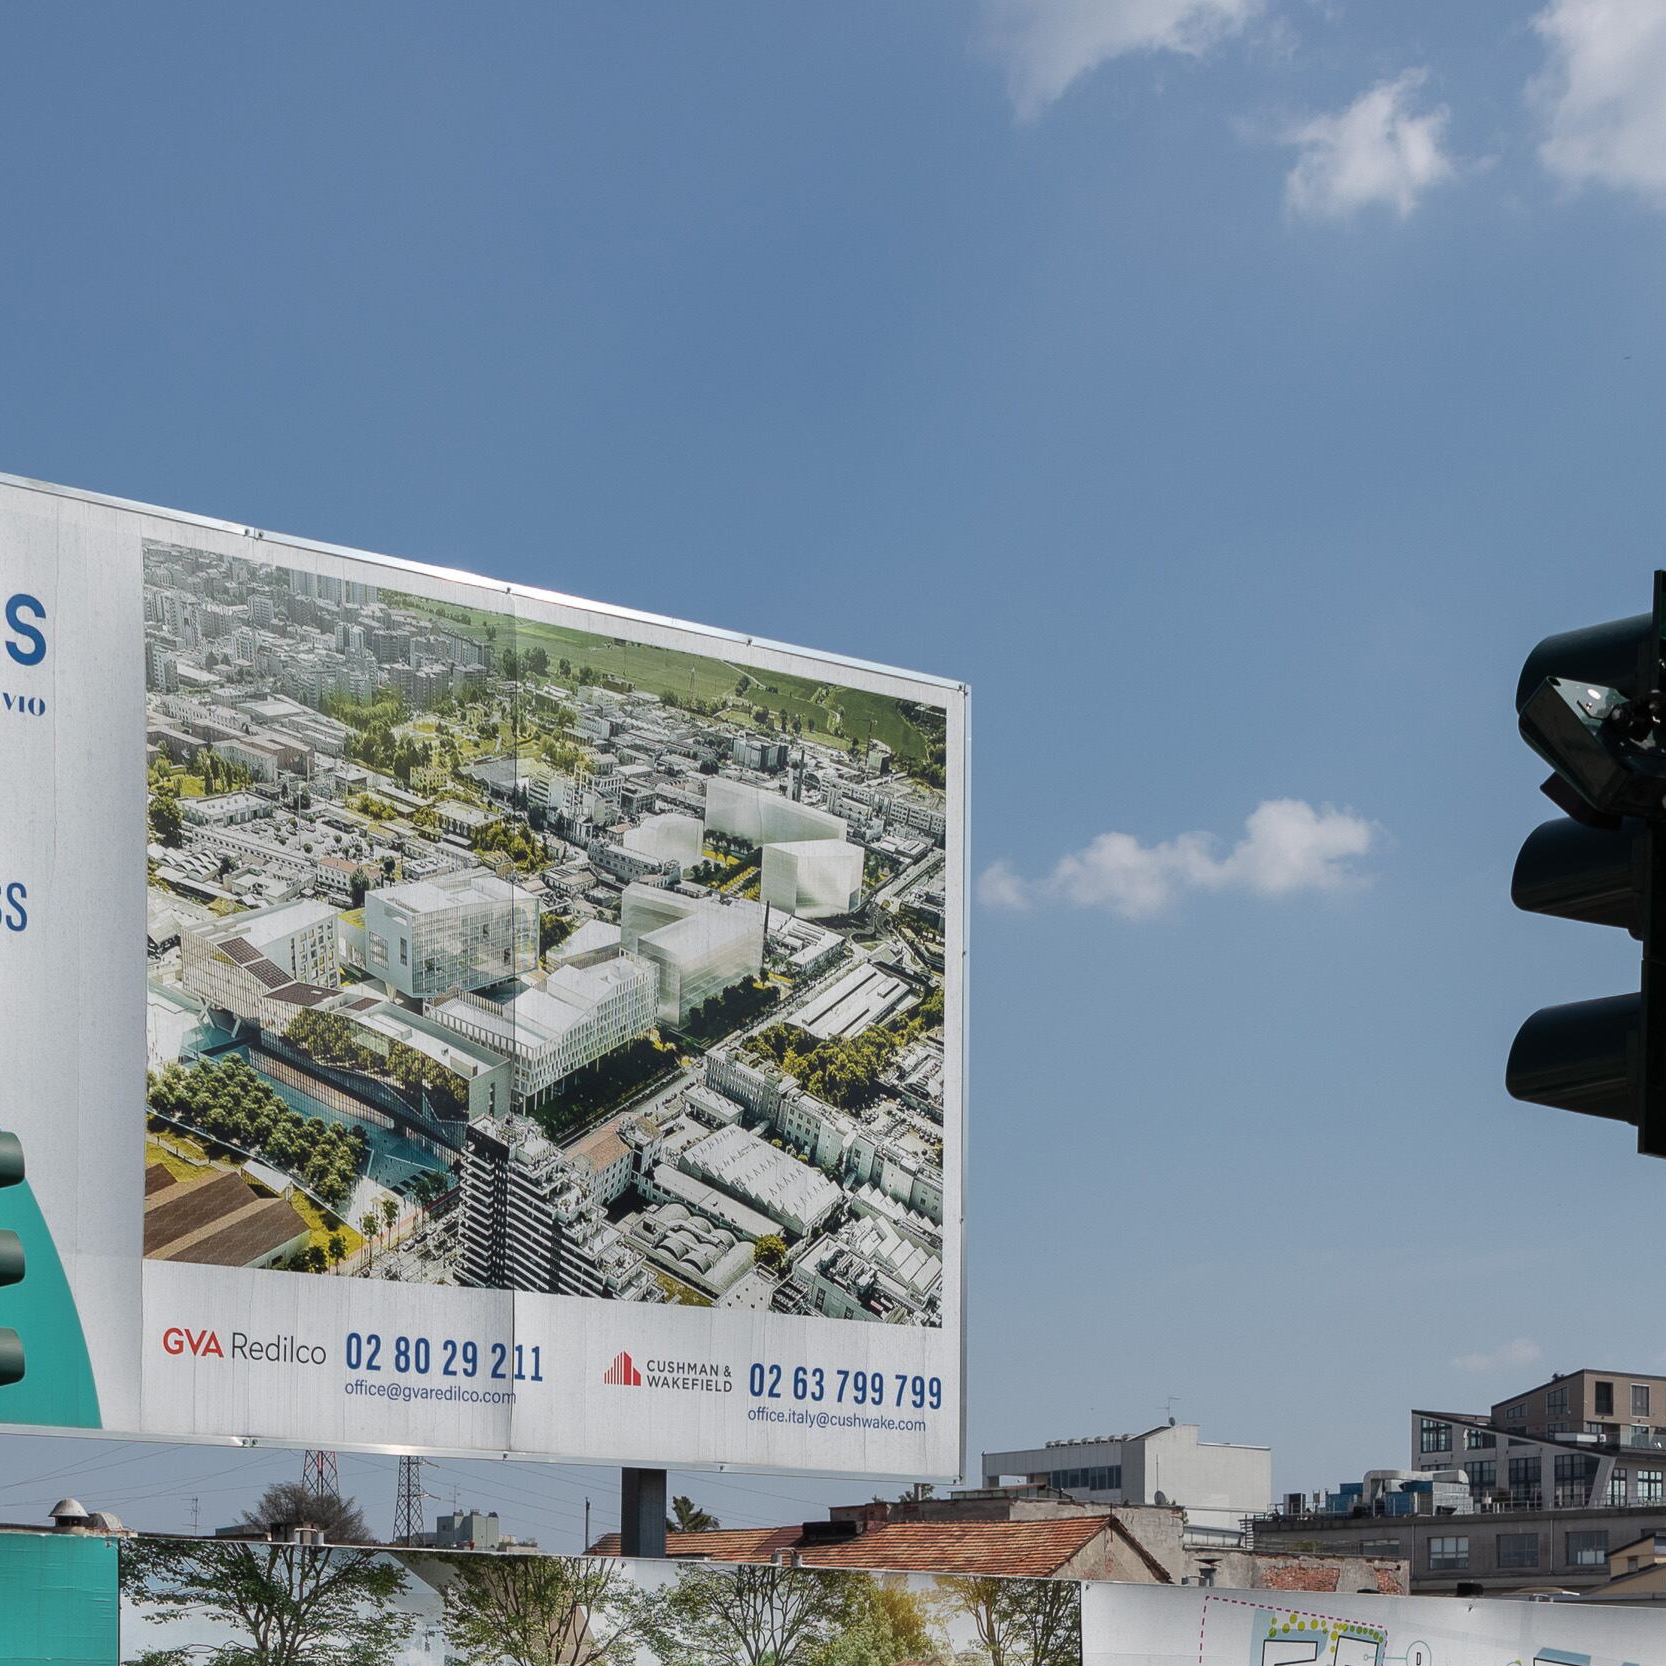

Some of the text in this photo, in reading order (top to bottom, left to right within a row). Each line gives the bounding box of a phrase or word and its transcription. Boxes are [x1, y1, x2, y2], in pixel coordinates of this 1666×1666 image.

[162, 1327, 326, 1365] GVA Redilco
[345, 1332, 544, 1382] 02 80 29 211
[647, 1359, 733, 1378] CUSHMAN &
[345, 1379, 517, 1405] office@gvaredilco.com
[646, 1375, 733, 1393] WAKEFIELD
[749, 1363, 942, 1410] 02 63 799 799
[748, 1406, 926, 1432] office.italy@cushwake.com
[1415, 1652, 1422, 1666] D
